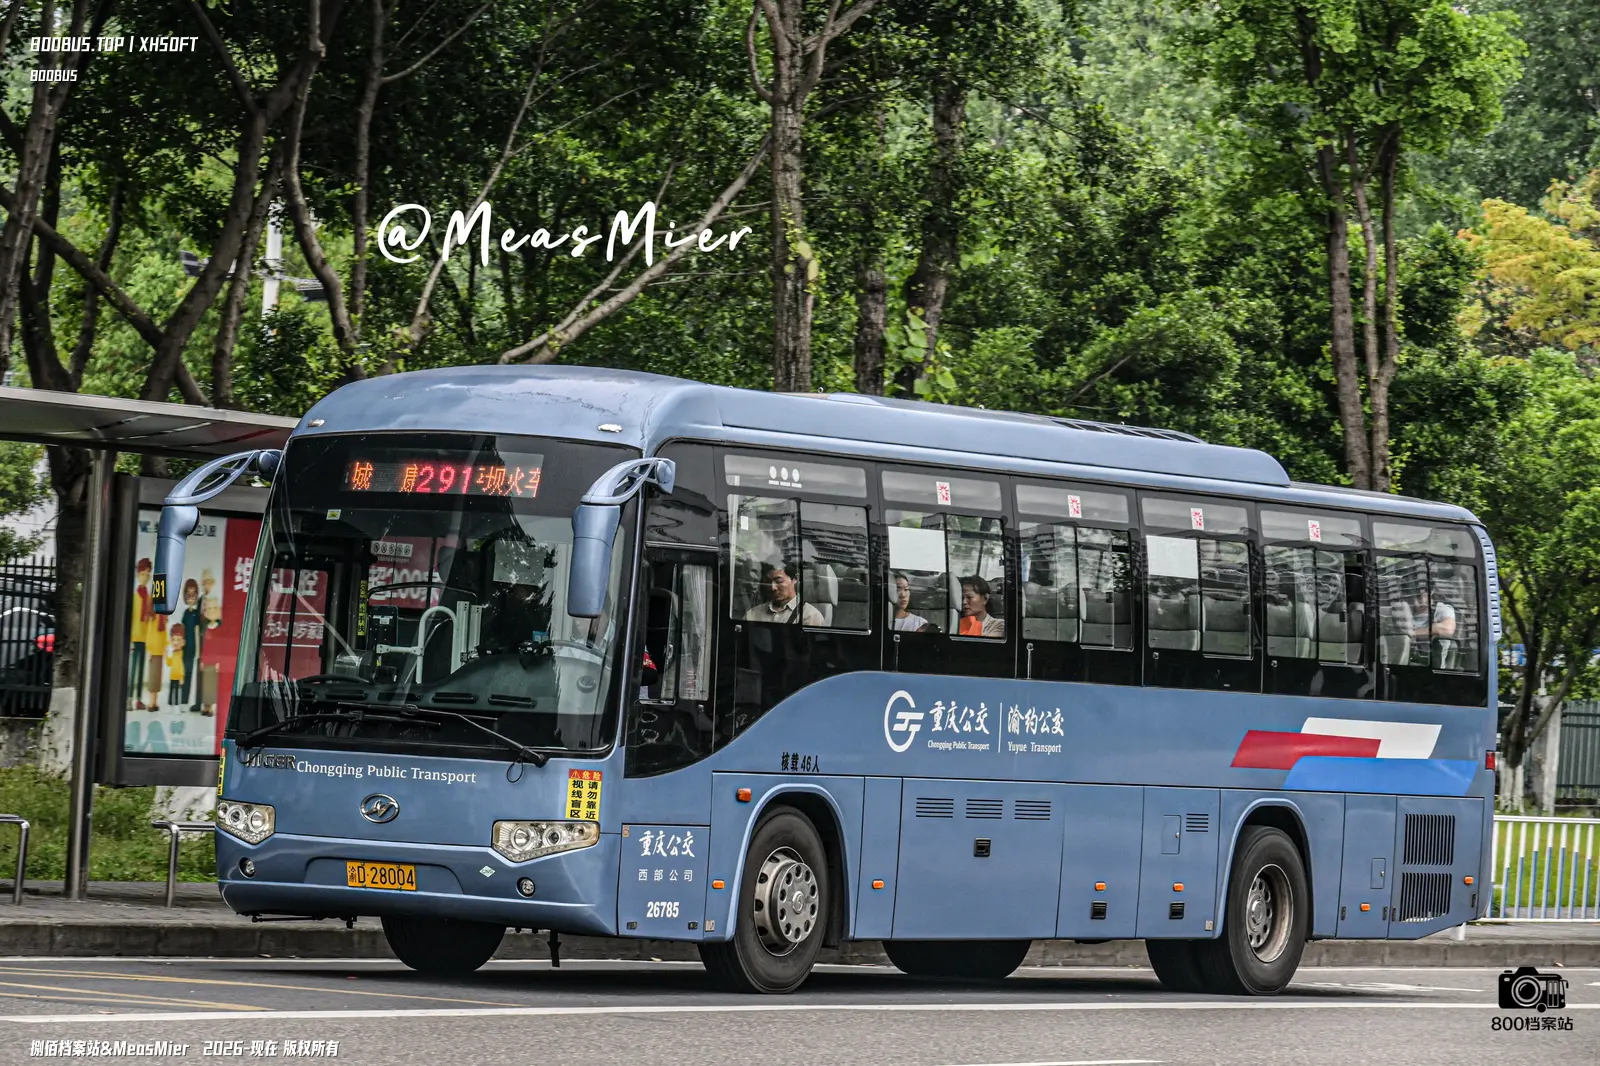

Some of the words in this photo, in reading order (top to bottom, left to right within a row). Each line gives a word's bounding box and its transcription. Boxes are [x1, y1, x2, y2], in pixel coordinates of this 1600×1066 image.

[416, 466, 472, 494] 291
[152, 580, 165, 598] 291
[929, 700, 990, 735] 重庆公交
[952, 740, 967, 750] Public
[967, 741, 990, 751] Transport
[1007, 741, 1027, 755] Yuyue
[1031, 742, 1062, 756] Transport
[296, 760, 363, 779] Chongqing
[367, 765, 407, 779] Public
[411, 767, 477, 784] Transport
[582, 770, 601, 780] 危险
[570, 779, 584, 818] 视线盲区
[585, 780, 599, 819] 请勿靠近
[638, 830, 696, 858] 重庆公交
[638, 868, 693, 882] 西部公司
[646, 901, 680, 918] 26785
